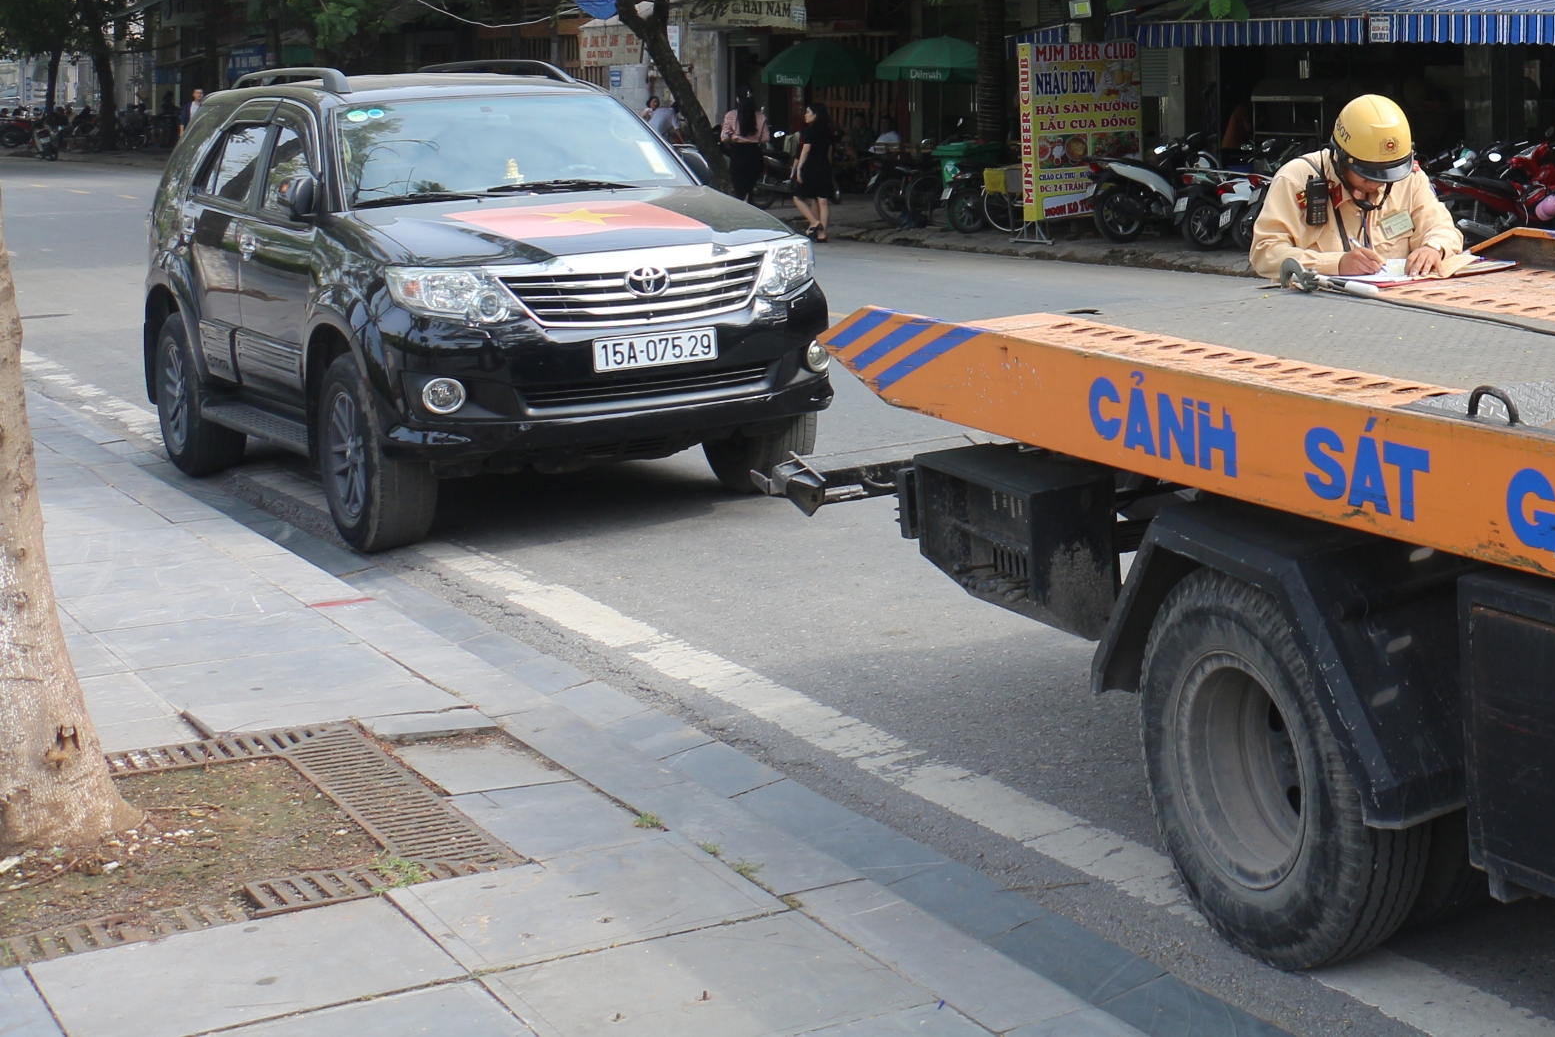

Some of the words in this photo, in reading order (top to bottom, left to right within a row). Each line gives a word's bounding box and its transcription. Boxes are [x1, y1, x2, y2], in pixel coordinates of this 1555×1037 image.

[766, 1, 791, 17] NAM
[1035, 45, 1065, 62] MJM
[1069, 43, 1100, 61] BEER
[1104, 42, 1137, 60] CLUB
[776, 74, 803, 85] Dilmah
[909, 69, 942, 79] Dilmah
[1018, 57, 1030, 105] CLUB
[1035, 65, 1069, 101] NHẬU
[1072, 64, 1096, 94] ĐÊM
[1035, 102, 1060, 115] HẢI
[1063, 101, 1090, 114] SẢN
[1093, 99, 1139, 112] NƯỚNG
[1039, 116, 1066, 131] LẨU
[1070, 119, 1097, 129] CUA
[1100, 114, 1137, 128] ĐỒNG
[1020, 111, 1032, 157] BEER
[1023, 162, 1034, 204] MJM
[1054, 184, 1063, 192] 24
[600, 333, 712, 367] 15A-075.29
[1088, 370, 1238, 479] CẢNH
[1304, 416, 1430, 522] SÁT
